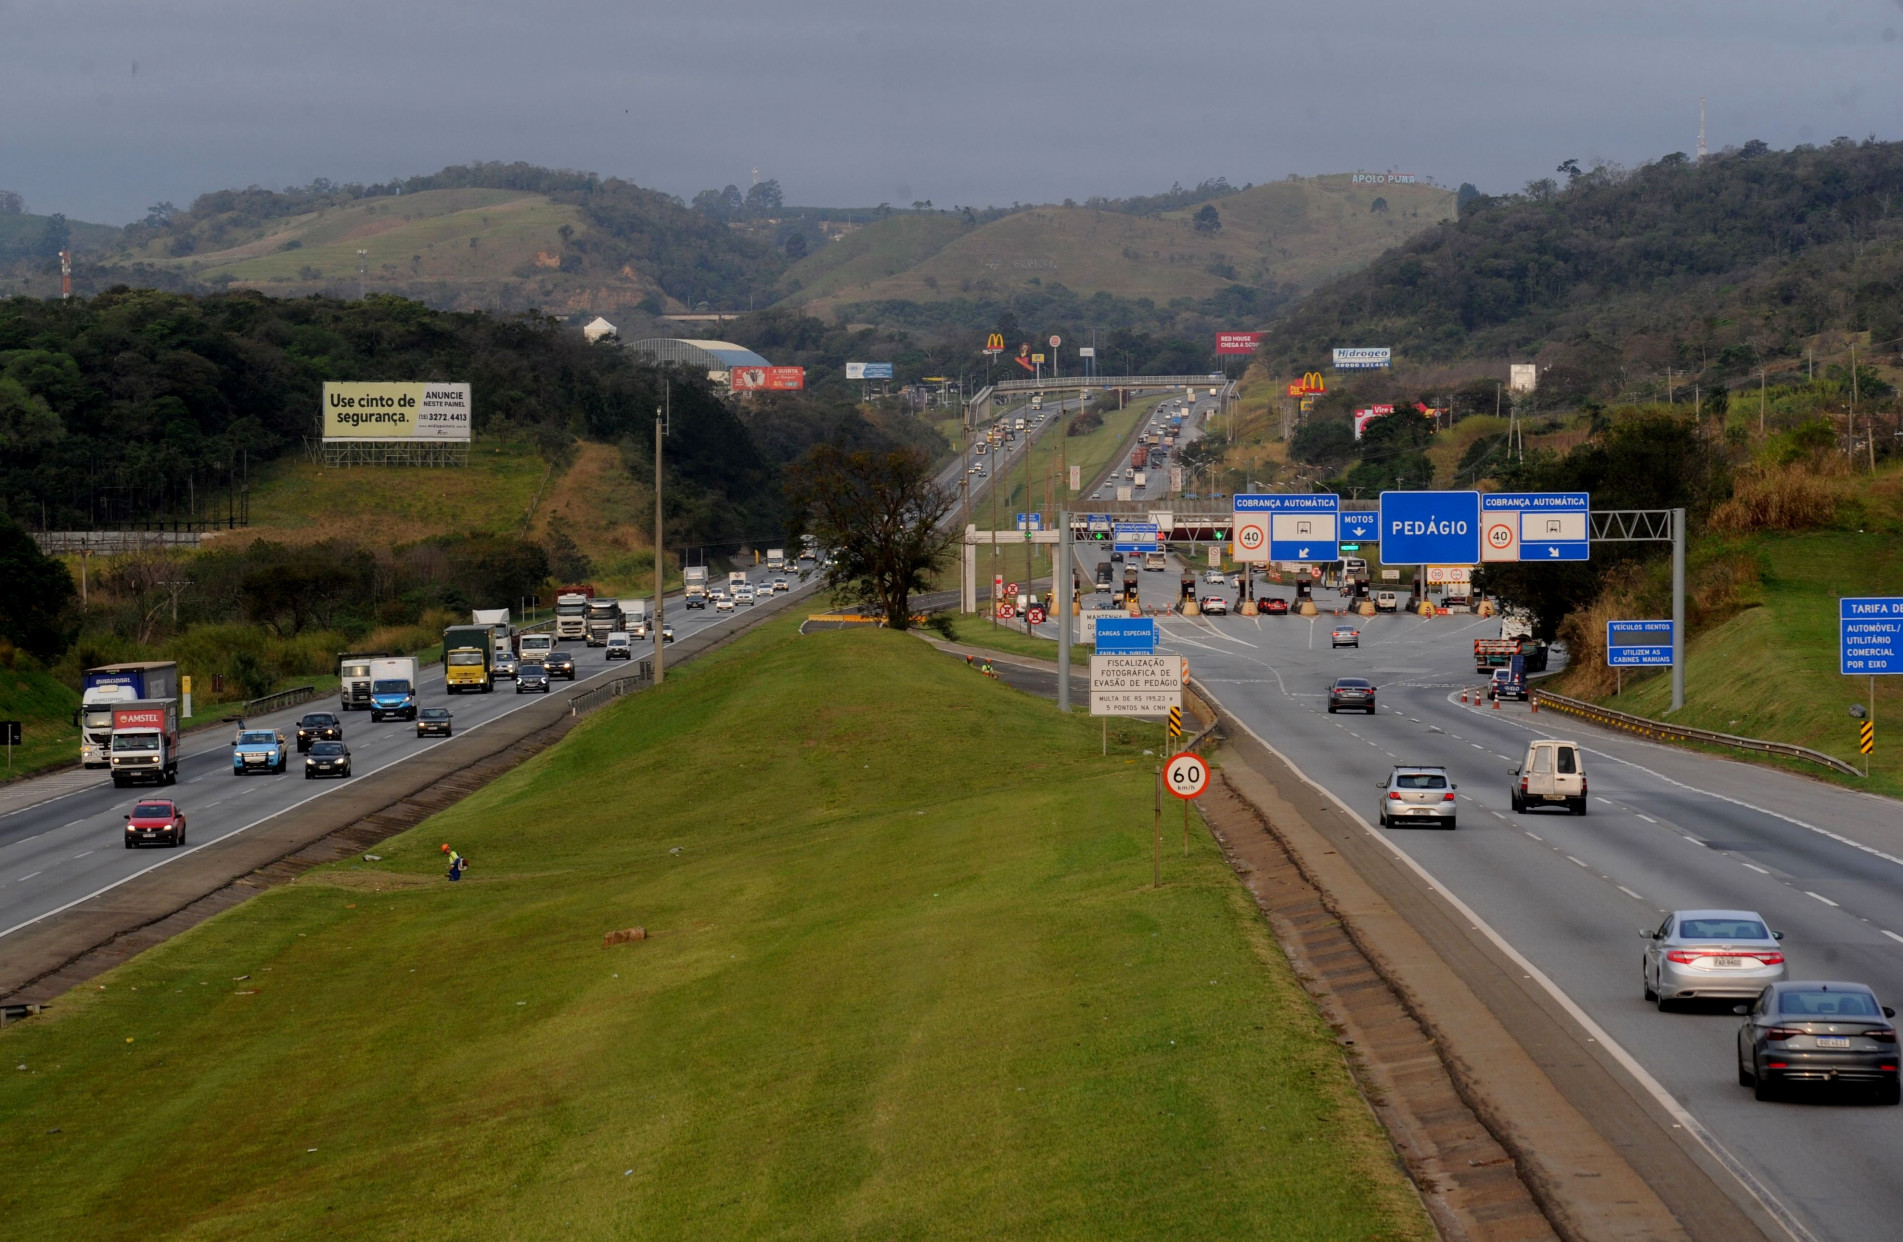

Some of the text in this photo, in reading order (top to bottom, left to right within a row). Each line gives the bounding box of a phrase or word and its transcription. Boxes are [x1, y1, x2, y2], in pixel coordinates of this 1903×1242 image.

[1352, 174, 1415, 184] APOLO PUMA
[330, 393, 416, 408] Use cinto de
[425, 391, 463, 400] ANUNCIE
[337, 411, 410, 427] segurança.
[1236, 496, 1335, 509] COBRANÇA AUTOMÁTICA
[1485, 495, 1585, 507] COBRANÇA AUTOMÁTICA
[1344, 515, 1374, 524] MOTOS
[1392, 515, 1468, 535] PEDÁGIO
[1244, 532, 1259, 541] 40
[1493, 531, 1508, 541] 40
[1851, 604, 1888, 613] TARIFA
[1613, 622, 1643, 631] VEÍCULOS
[1847, 622, 1901, 633] AUTOMÓVEL/
[1846, 634, 1891, 645] UTILITÁRIO
[1847, 648, 1894, 657] COMERCIAL
[1107, 657, 1165, 667] FISCALIZAÇÃO
[1847, 660, 1887, 669] POR EIXO
[1101, 667, 1171, 677] FOTOGRÁFICA DE
[1094, 678, 1126, 687] EVASÃO
[1144, 678, 1178, 687] PEDÁGIO
[127, 714, 158, 723] AMSTEL
[1173, 765, 1200, 783] 60
